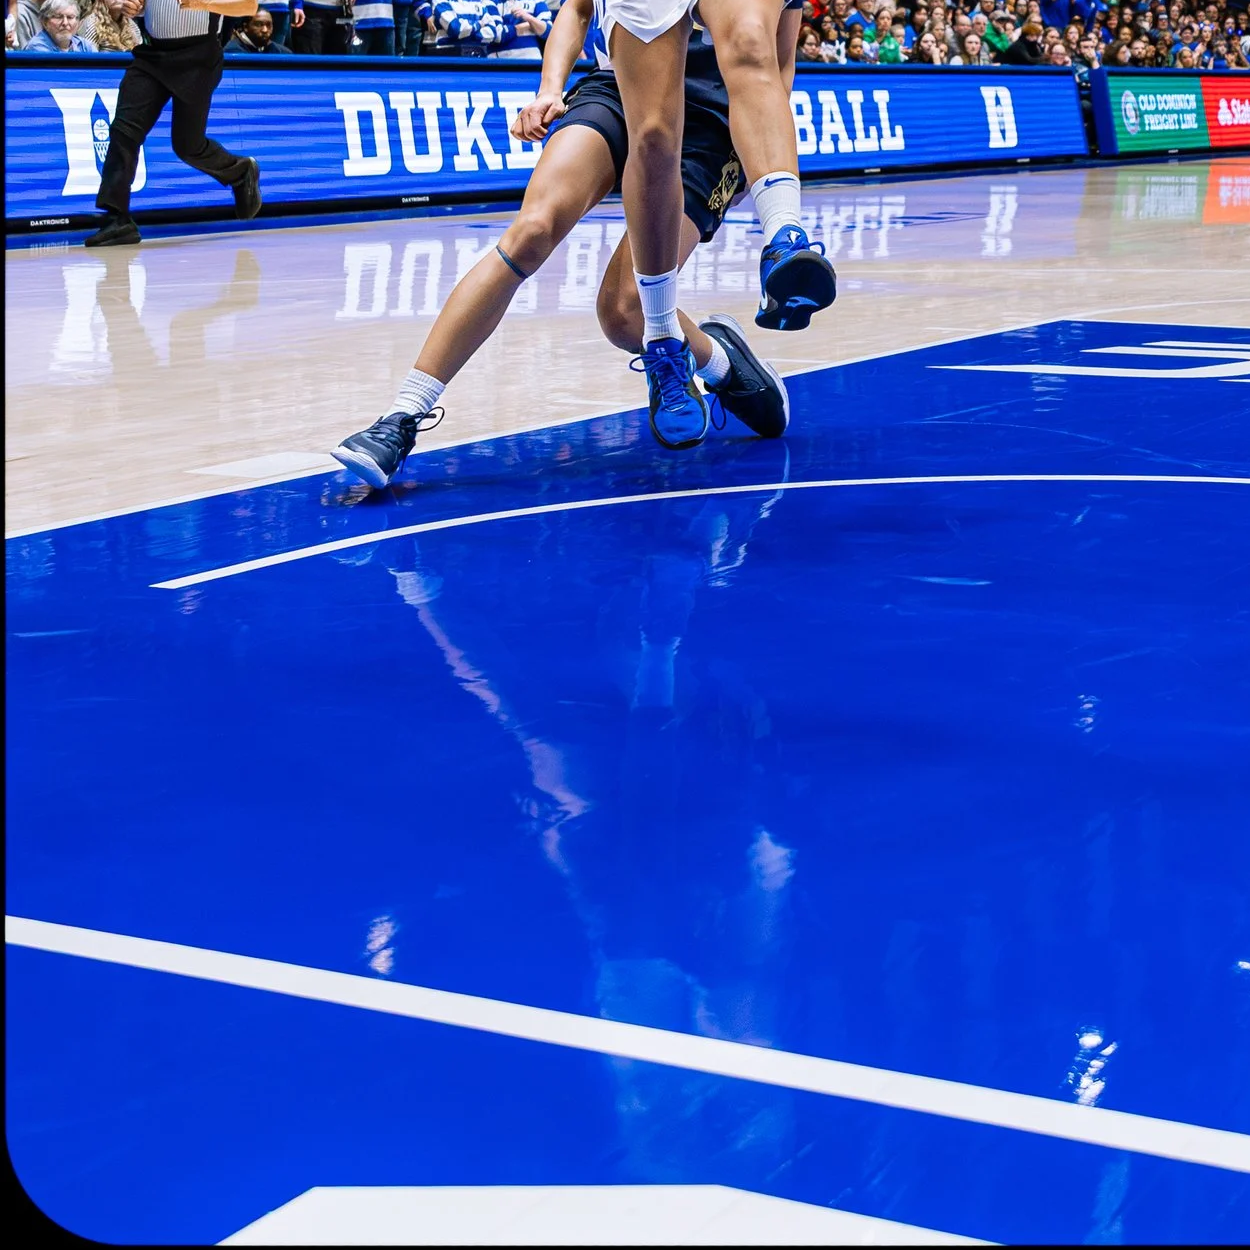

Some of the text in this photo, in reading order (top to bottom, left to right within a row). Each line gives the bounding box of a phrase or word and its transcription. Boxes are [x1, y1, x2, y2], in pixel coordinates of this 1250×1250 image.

[1138, 94, 1197, 110] OLD DOMINION
[1144, 114, 1198, 130] FREIGHT LINE
[30, 218, 70, 226] DAKTRONICS
